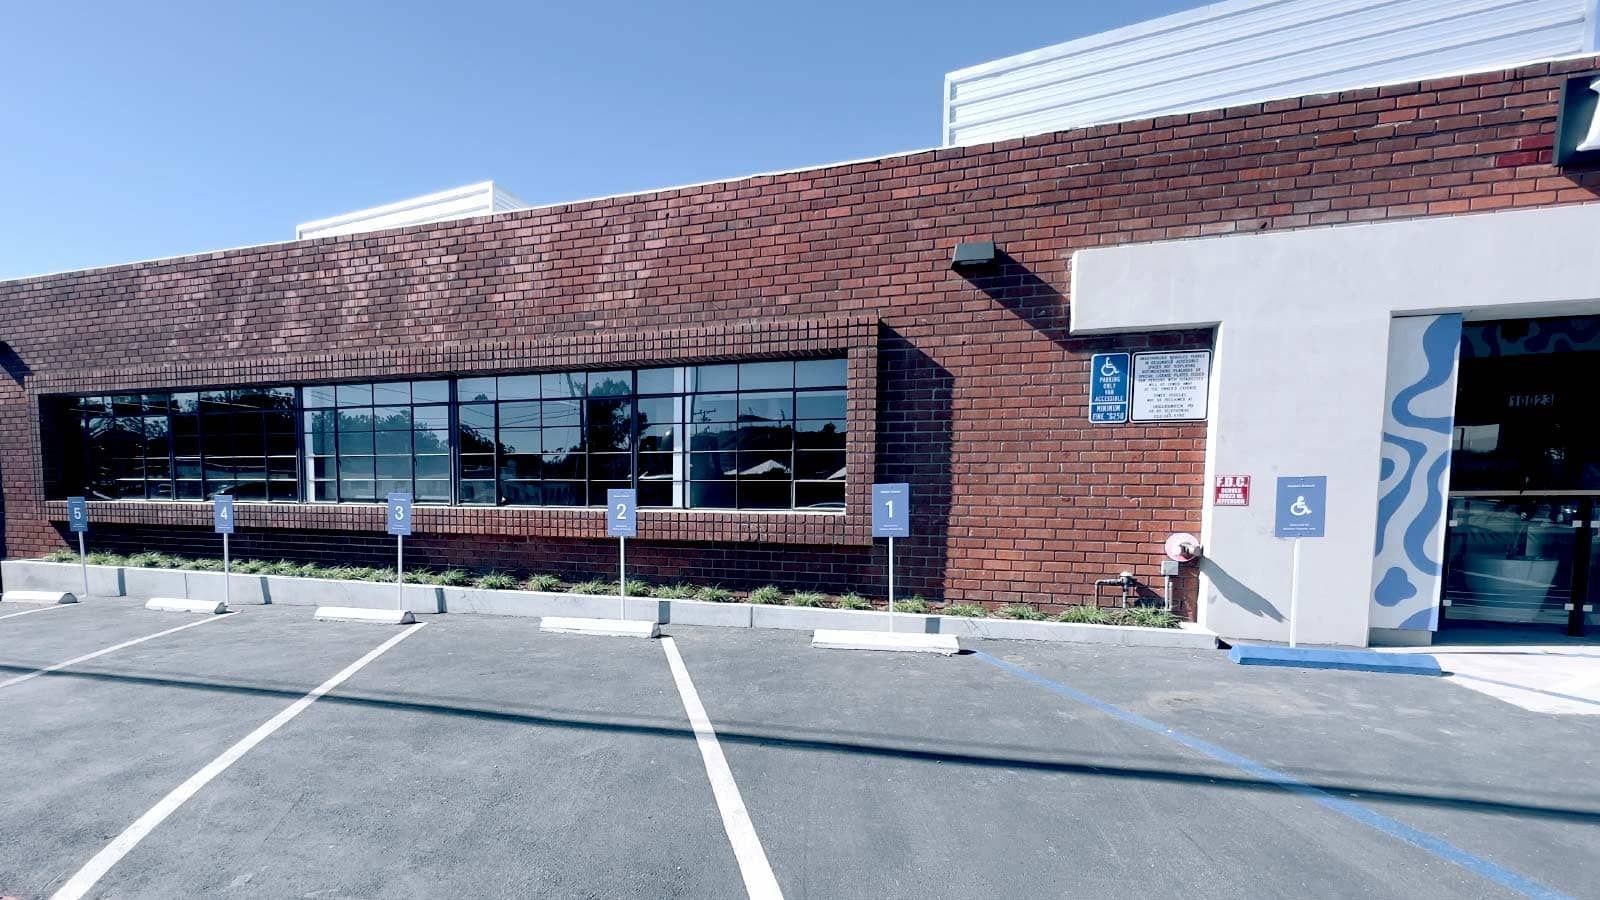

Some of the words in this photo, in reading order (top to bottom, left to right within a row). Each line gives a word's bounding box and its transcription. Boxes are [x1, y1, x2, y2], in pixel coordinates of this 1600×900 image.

[1216, 477, 1247, 487] F.D.C.
[74, 507, 81, 520] 5
[220, 506, 228, 520] 4
[395, 506, 404, 520] 3
[616, 504, 627, 520] 2
[885, 500, 893, 518] 1
